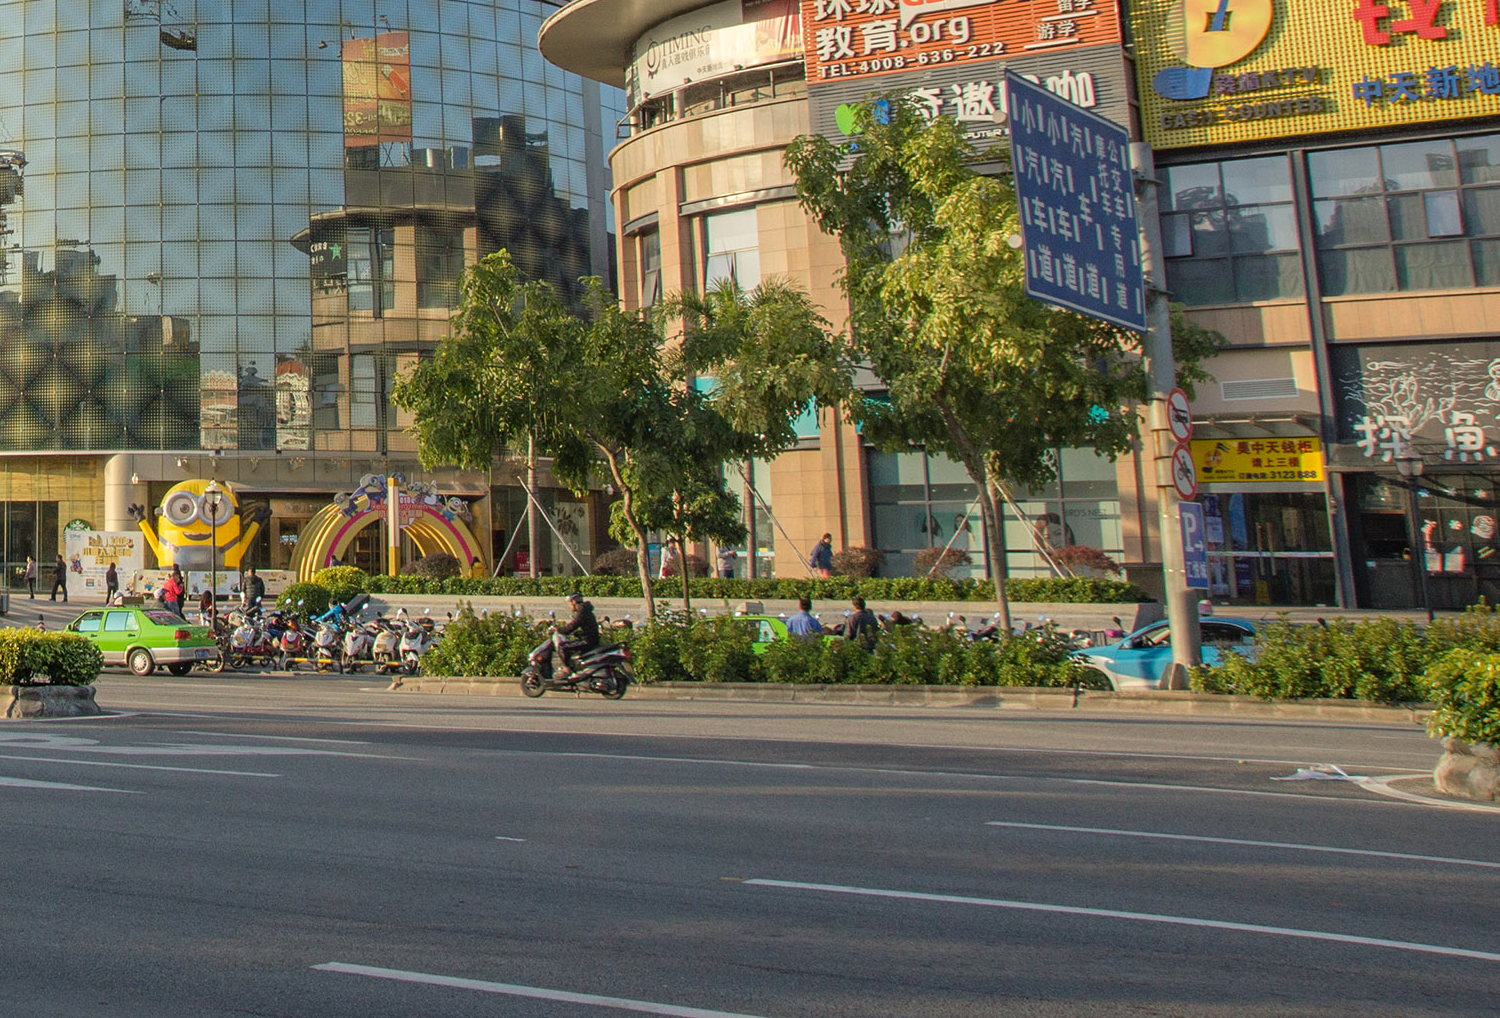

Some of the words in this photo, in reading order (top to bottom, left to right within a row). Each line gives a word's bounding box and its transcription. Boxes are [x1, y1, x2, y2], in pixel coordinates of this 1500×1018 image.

[1037, 19, 1077, 42] 游学
[1352, 62, 1500, 108] 中天新地
[1224, 96, 1324, 121] COUNTER
[1022, 98, 1055, 283] 小汽车道
[1047, 111, 1079, 292] 小汽车道
[1070, 122, 1101, 299] 汽车道
[1182, 511, 1198, 553] P
